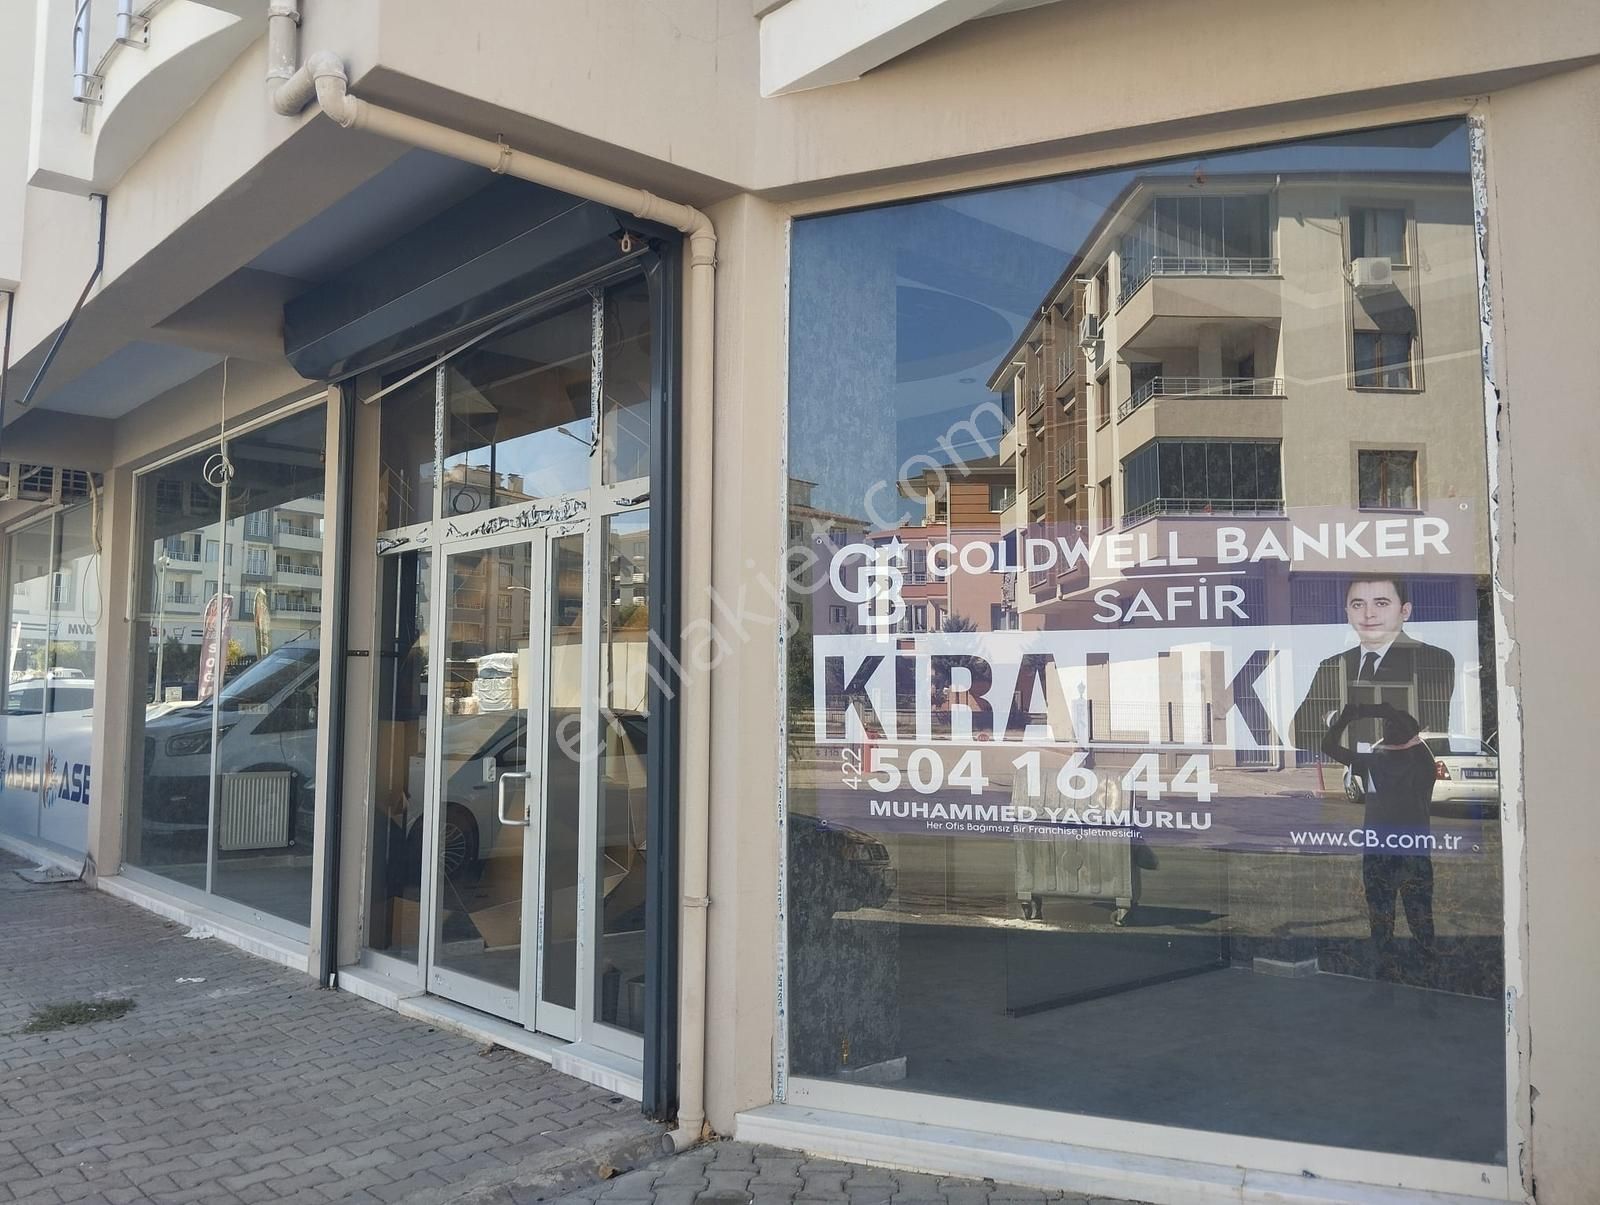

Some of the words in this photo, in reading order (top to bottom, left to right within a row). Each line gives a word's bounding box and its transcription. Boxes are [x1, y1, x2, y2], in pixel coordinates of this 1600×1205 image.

[928, 532, 1197, 576] COLDWELL
[1217, 517, 1451, 563] BANKER
[1093, 577, 1249, 622] SAFİR
[824, 638, 1284, 746] KİRALIK
[58, 760, 91, 805] ASE
[842, 748, 862, 790] 422
[869, 748, 989, 795] 504
[1012, 750, 1098, 799] 16
[1121, 753, 1218, 802] 44
[870, 800, 1037, 822] MUHAMMED
[1045, 804, 1212, 830] YAĞMURLU
[926, 821, 943, 830] Her
[945, 822, 965, 831] Ofis
[1013, 825, 1026, 833] Bir
[1029, 825, 1078, 835] Franchise
[1290, 829, 1463, 850] www.CB.com.tr
